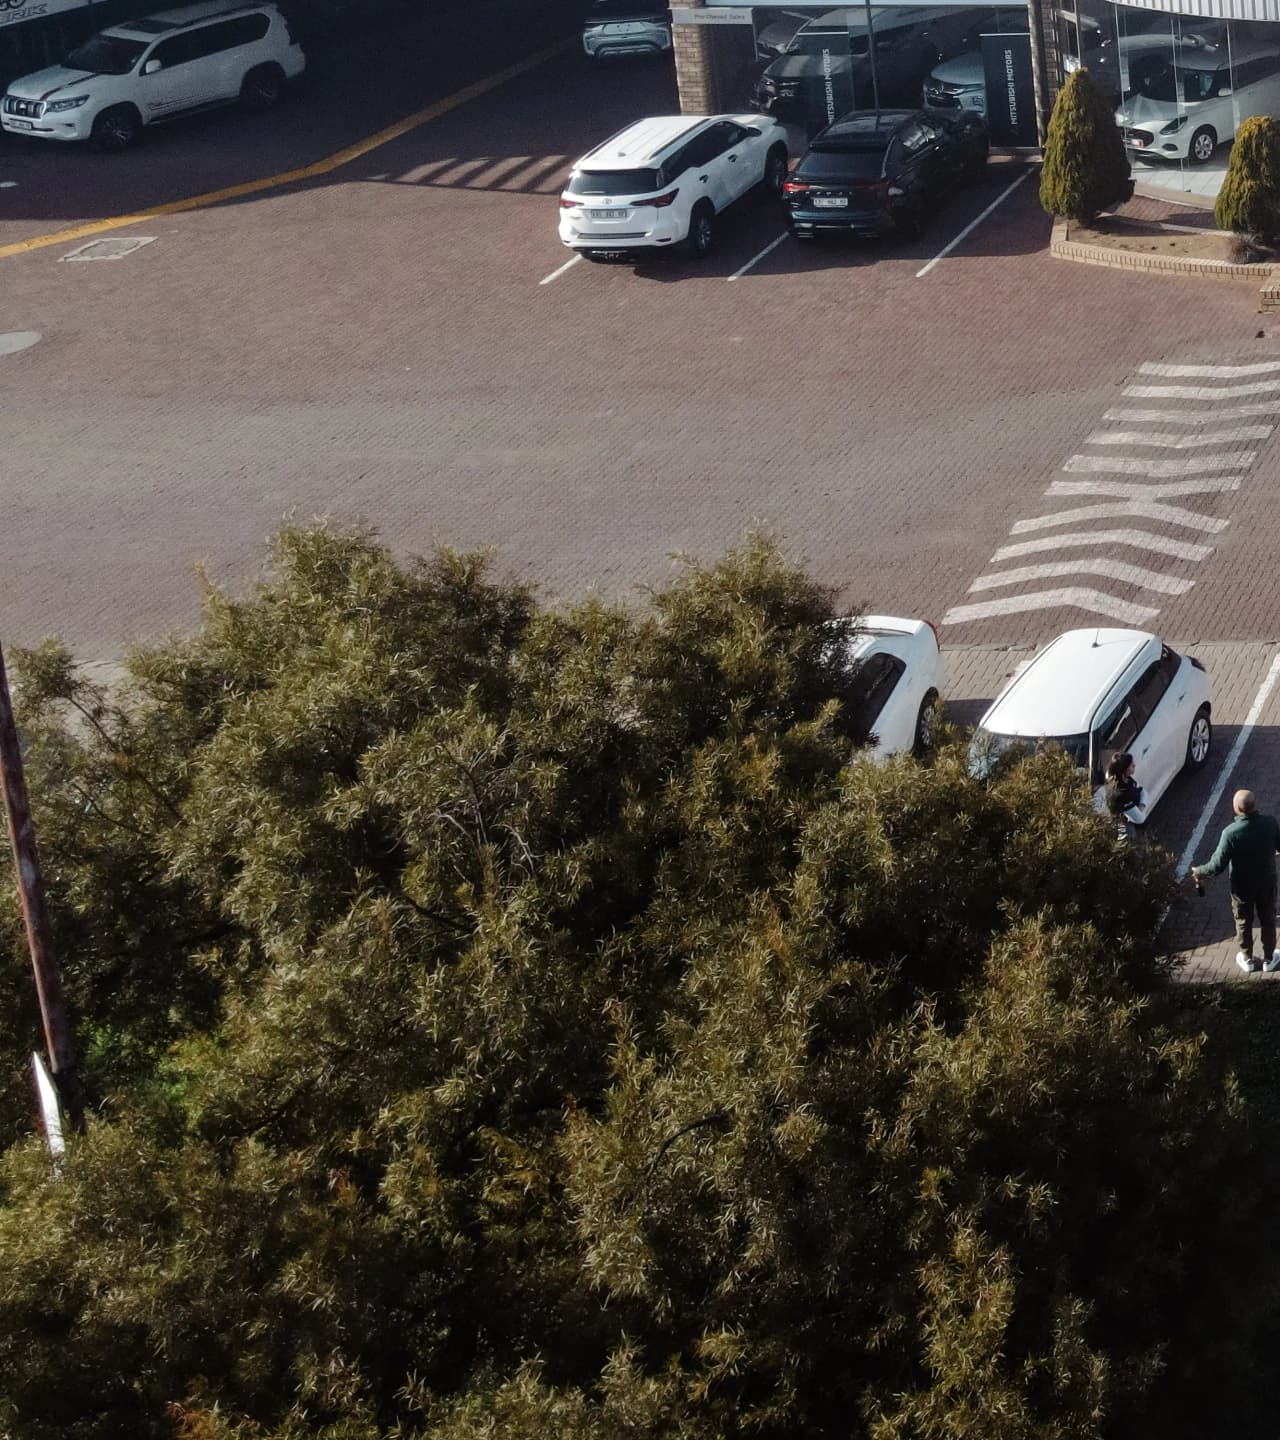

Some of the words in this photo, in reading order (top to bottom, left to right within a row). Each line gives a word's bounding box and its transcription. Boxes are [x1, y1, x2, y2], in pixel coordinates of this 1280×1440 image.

[822, 48, 832, 79] MOTORS
[1004, 49, 1014, 80] MOTORS
[1007, 81, 1019, 125] MITSUBISHI
